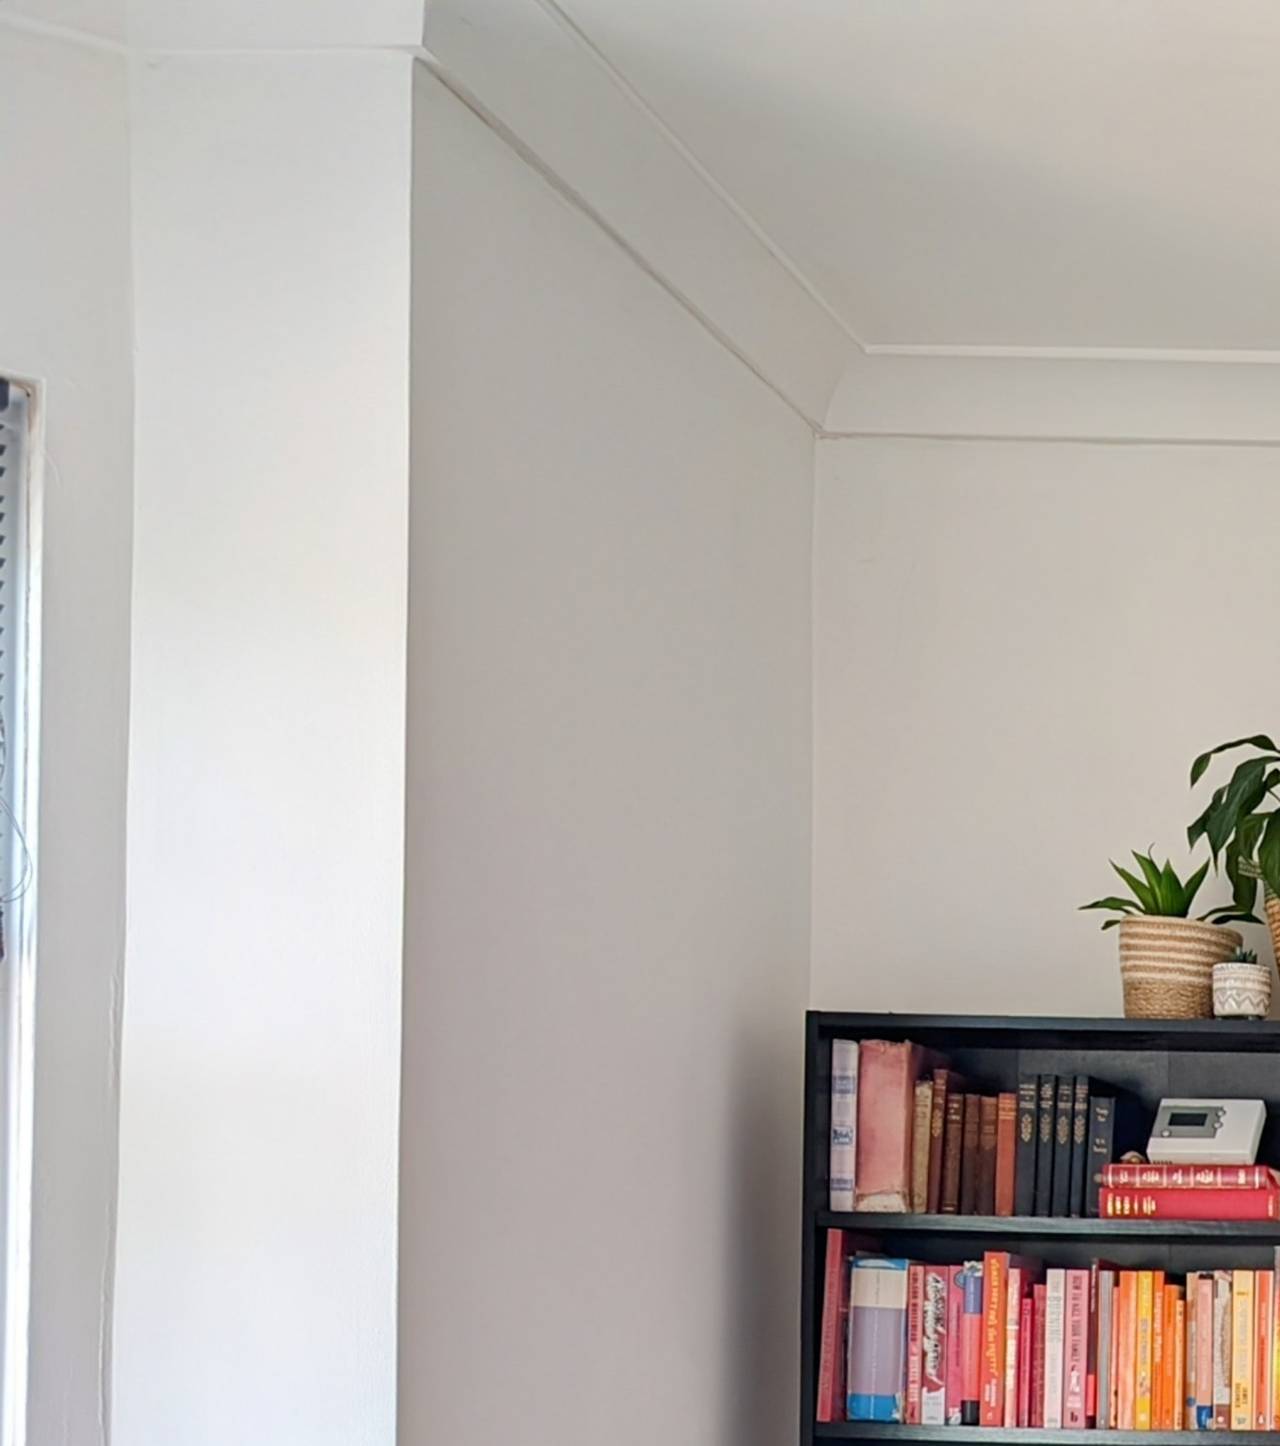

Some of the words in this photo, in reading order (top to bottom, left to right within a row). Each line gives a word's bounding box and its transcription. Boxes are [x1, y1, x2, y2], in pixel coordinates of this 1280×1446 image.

[1072, 1275, 1082, 1290] HOW
[1072, 1292, 1082, 1302] TO
[1072, 1304, 1082, 1317] KILL
[1072, 1320, 1082, 1337] YOUR
[1071, 1339, 1081, 1362] FAMILY
